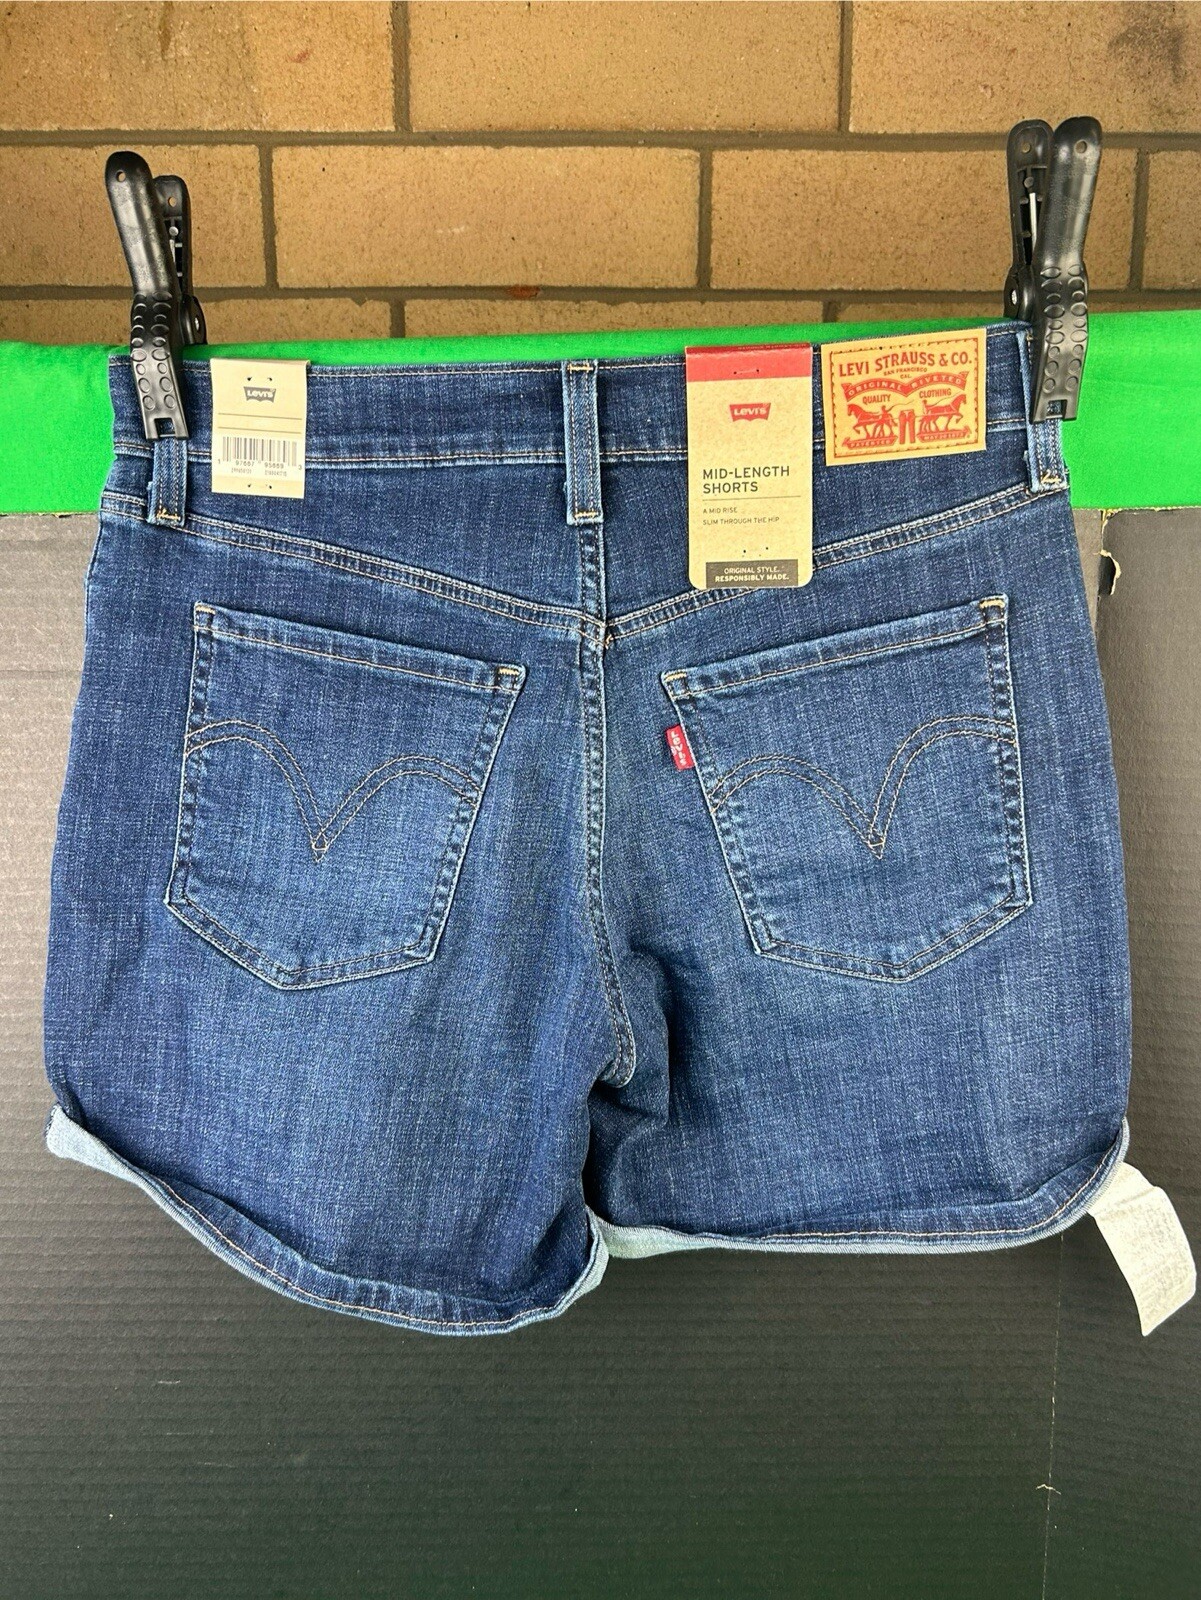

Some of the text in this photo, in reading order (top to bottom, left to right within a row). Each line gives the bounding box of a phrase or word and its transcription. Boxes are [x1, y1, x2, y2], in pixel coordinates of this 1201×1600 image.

[839, 351, 972, 377] LEVI STRAUSS & CO.
[848, 374, 962, 396] ORIGINAL RIVETED
[862, 388, 952, 406] QUALITY CLOTHING
[702, 466, 790, 480] MID-LENGTH
[702, 481, 759, 494] SHORTS
[715, 574, 765, 582] RESPONSIBLY
